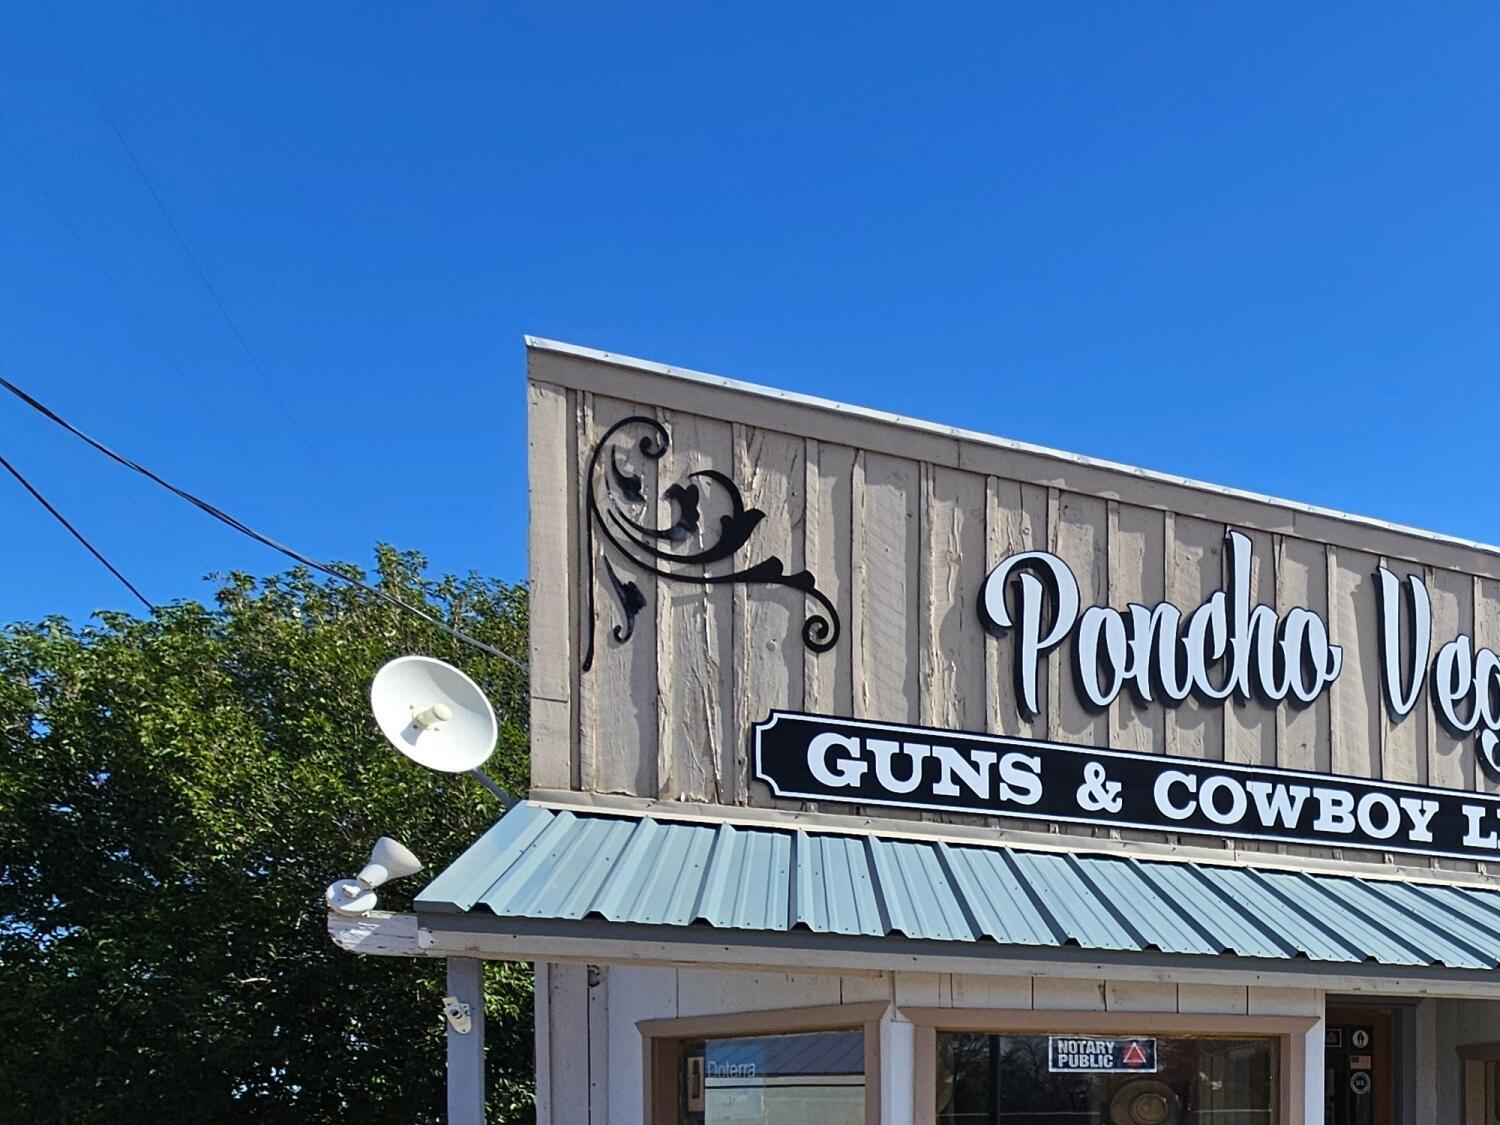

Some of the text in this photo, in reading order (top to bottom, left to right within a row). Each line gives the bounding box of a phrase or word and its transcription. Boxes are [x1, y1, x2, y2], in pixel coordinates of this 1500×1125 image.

[979, 529, 1343, 719] Poncho
[806, 731, 1043, 805] GUNS
[1076, 762, 1122, 814] &
[1154, 771, 1440, 843] COWBOY
[1058, 1040, 1115, 1055] NOTARY
[1059, 1054, 1114, 1069] PUBLIC
